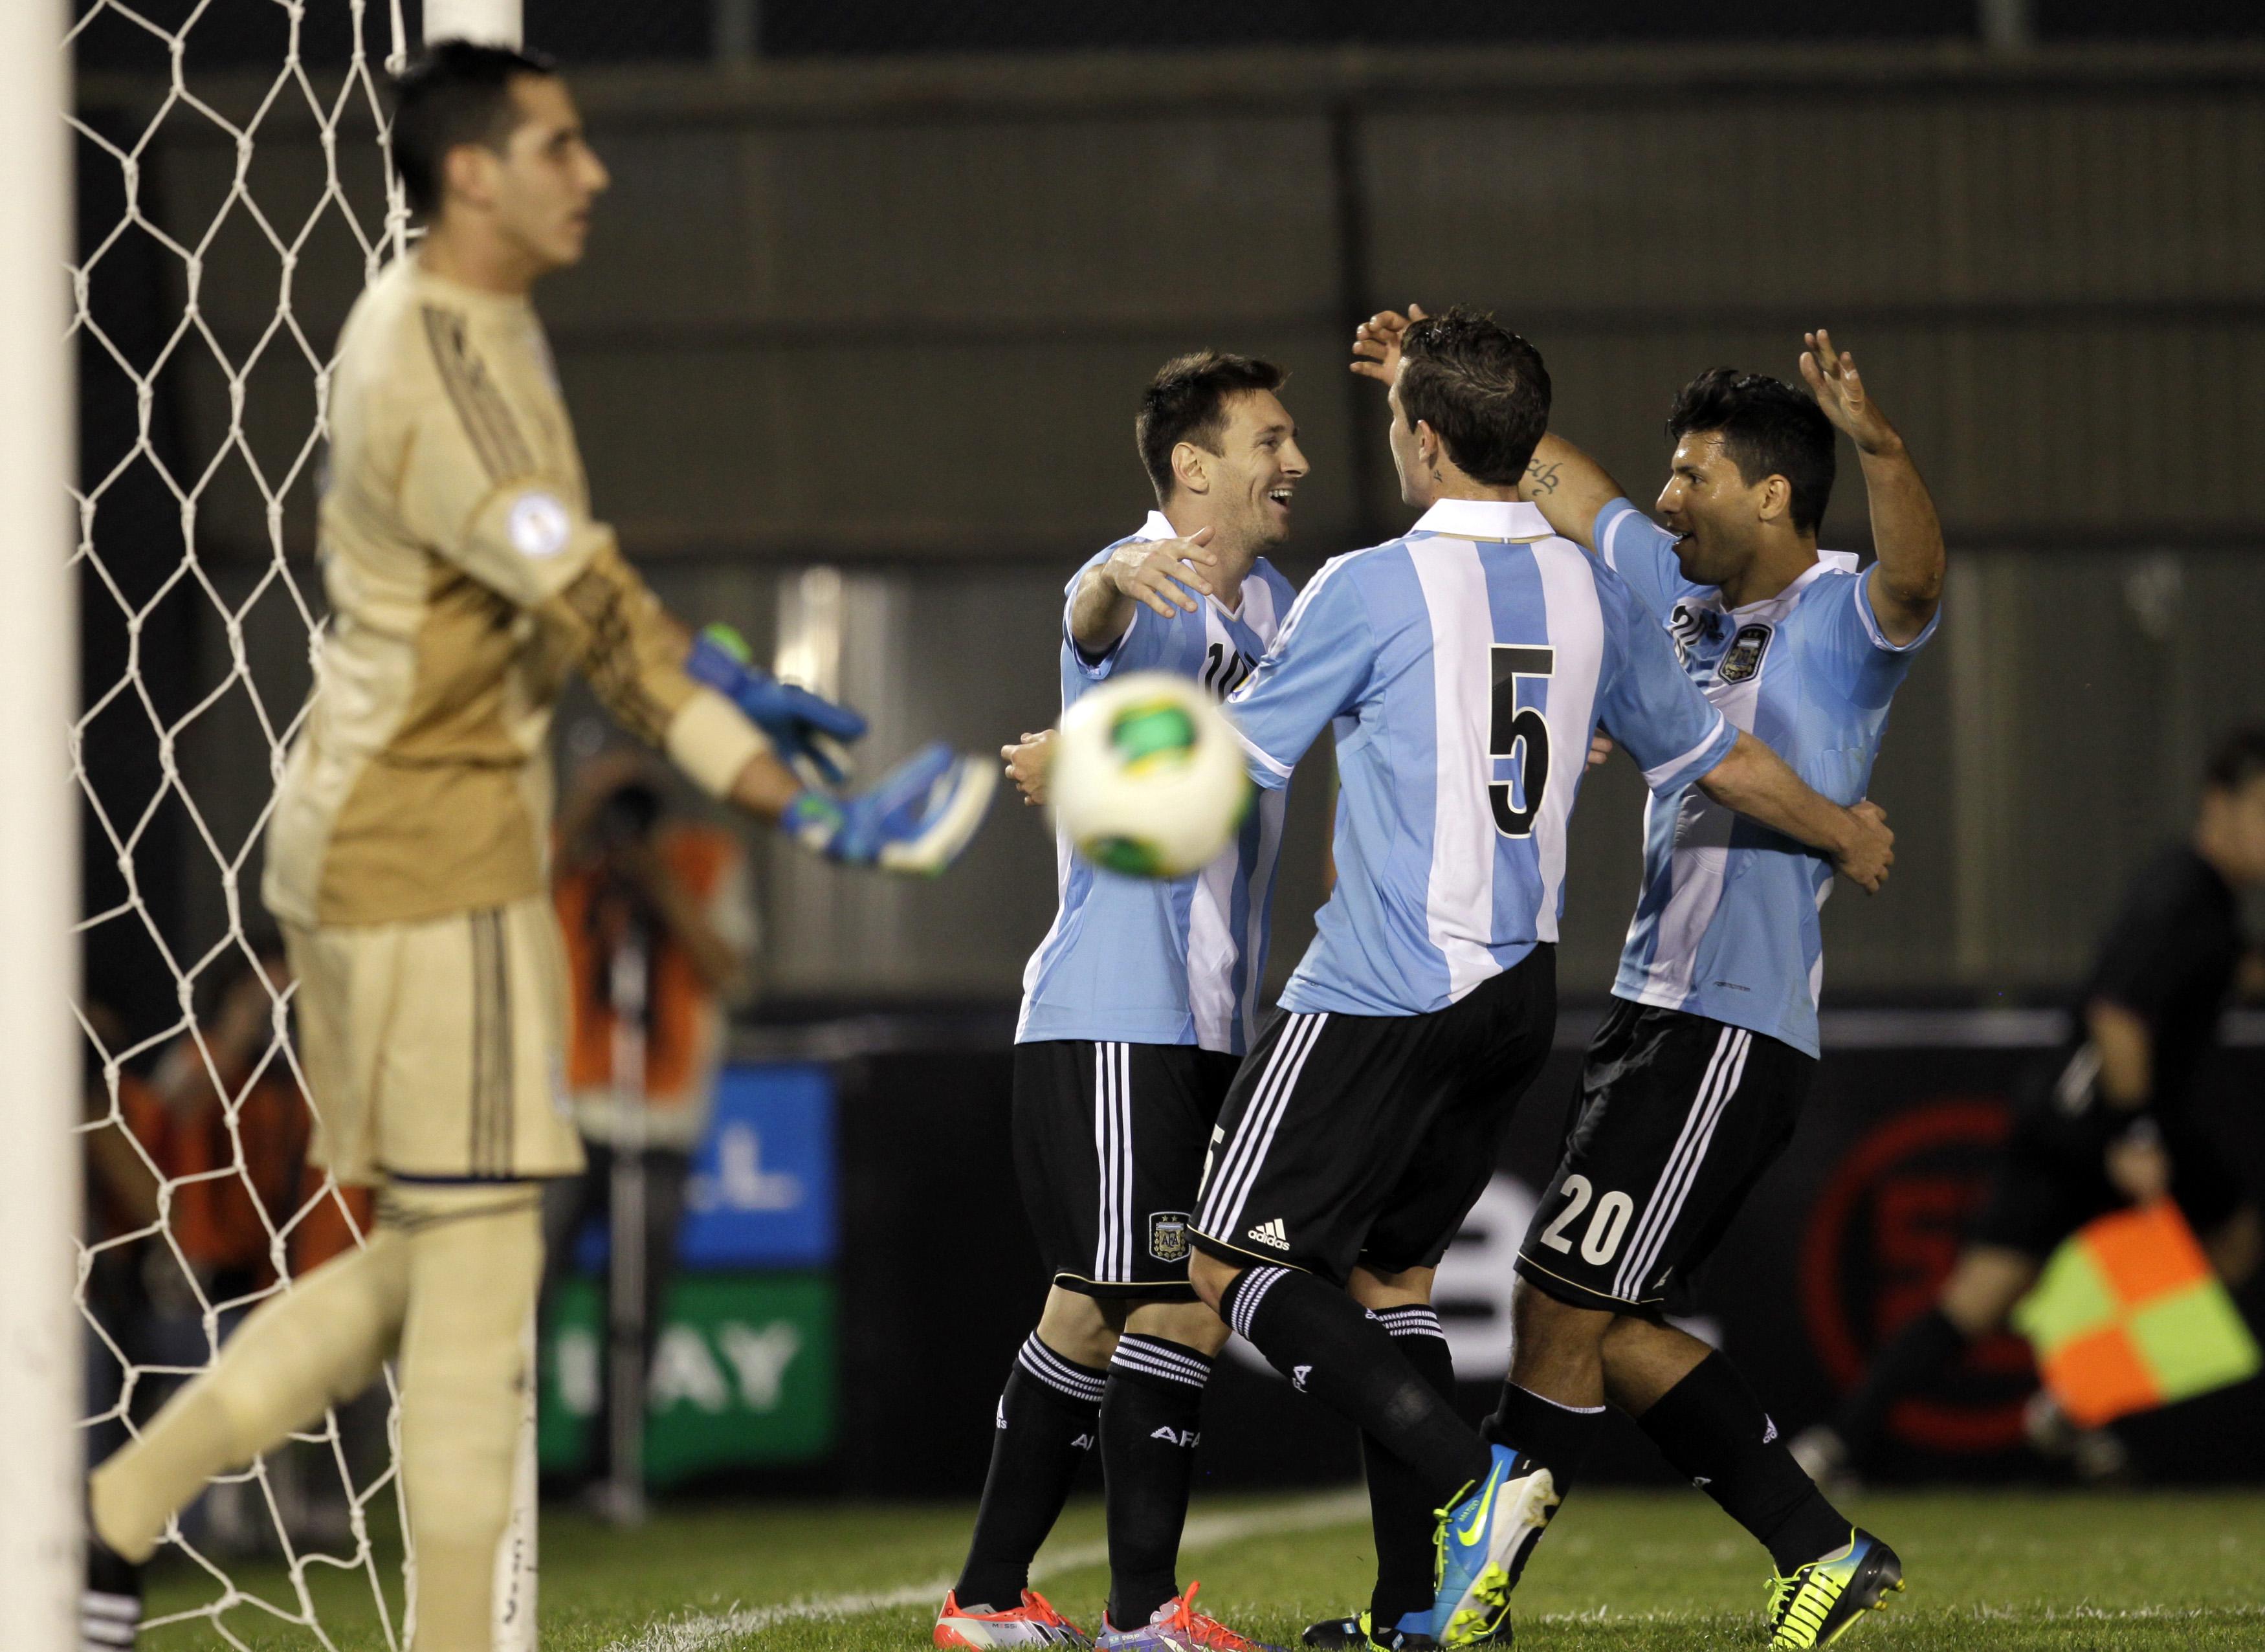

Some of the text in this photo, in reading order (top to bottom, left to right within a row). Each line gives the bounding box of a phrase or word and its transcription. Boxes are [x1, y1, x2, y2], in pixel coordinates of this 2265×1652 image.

[1488, 644, 1554, 839] 5
[1540, 1174, 1634, 1266] 20
[1248, 1229, 1290, 1251] adidas
[1292, 1365, 1313, 1393] FA
[1150, 1426, 1201, 1448] AFA
